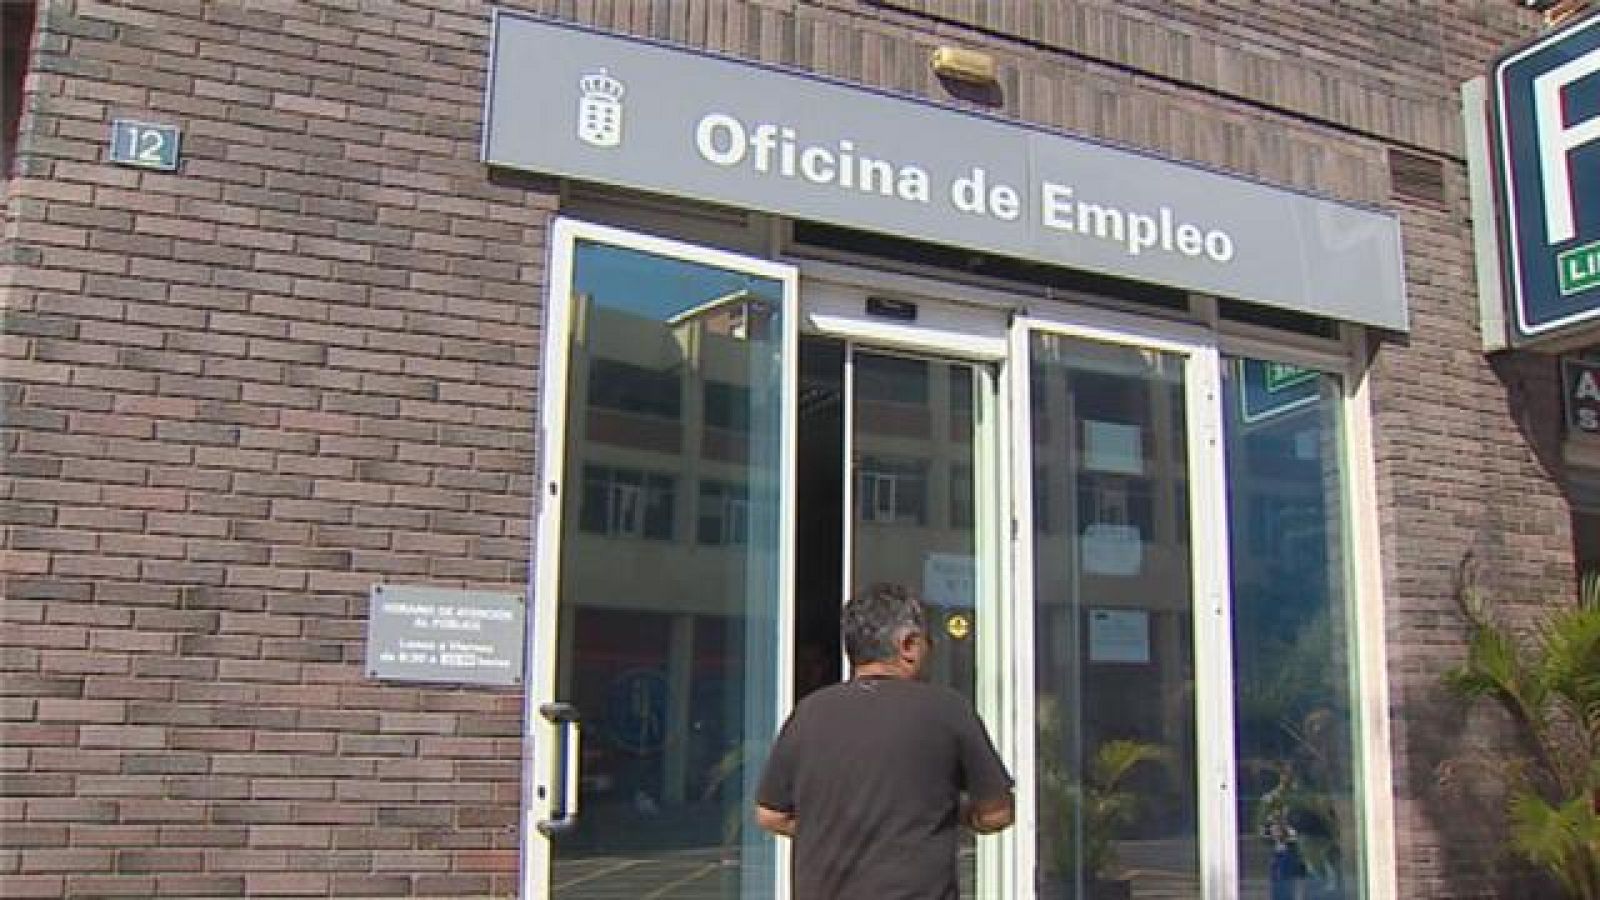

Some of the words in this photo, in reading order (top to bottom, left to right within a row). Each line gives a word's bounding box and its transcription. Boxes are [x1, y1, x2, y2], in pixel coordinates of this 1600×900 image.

[128, 127, 164, 161] 12
[694, 112, 931, 203] Oficina
[951, 168, 1021, 221] de
[1041, 181, 1236, 264] Empleo
[1569, 250, 1600, 281] LI
